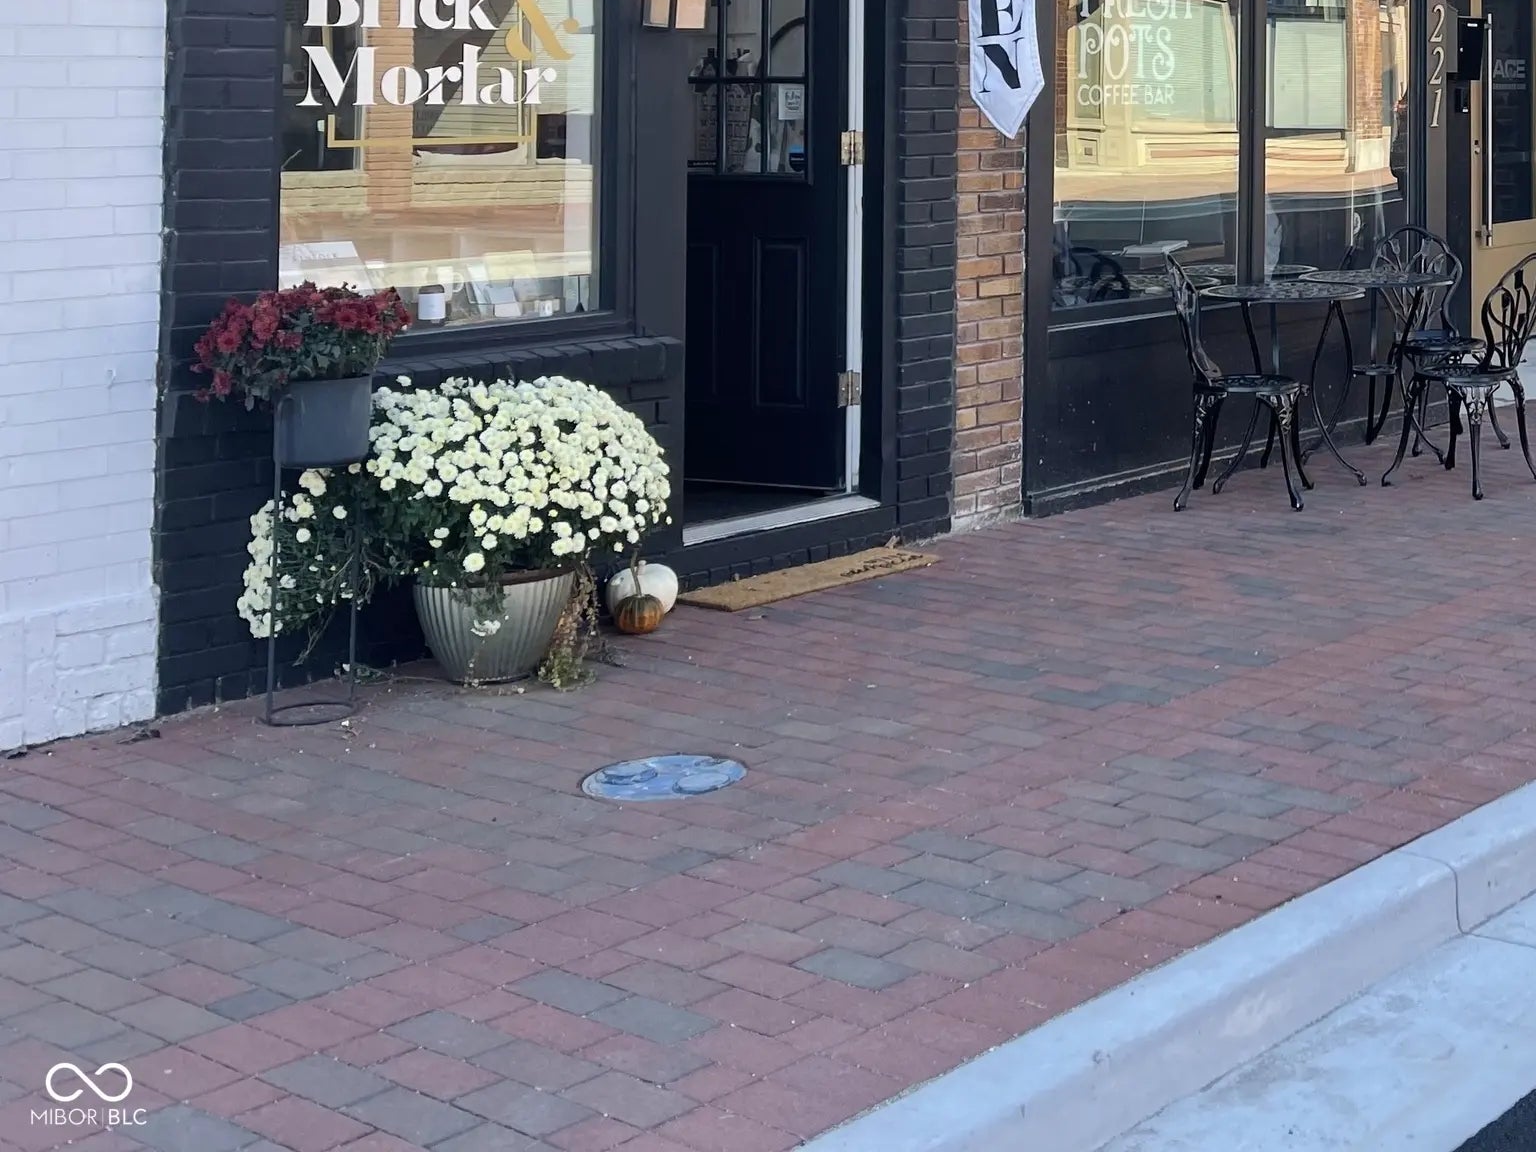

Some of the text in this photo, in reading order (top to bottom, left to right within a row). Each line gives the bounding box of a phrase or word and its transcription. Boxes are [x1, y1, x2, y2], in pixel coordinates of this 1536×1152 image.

[296, 43, 558, 107] Mortar
[1077, 22, 1175, 80] POTS
[1428, 4, 1446, 128] 221
[1492, 59, 1526, 78] ACE
[1077, 84, 1175, 107] COFFEE BAR
